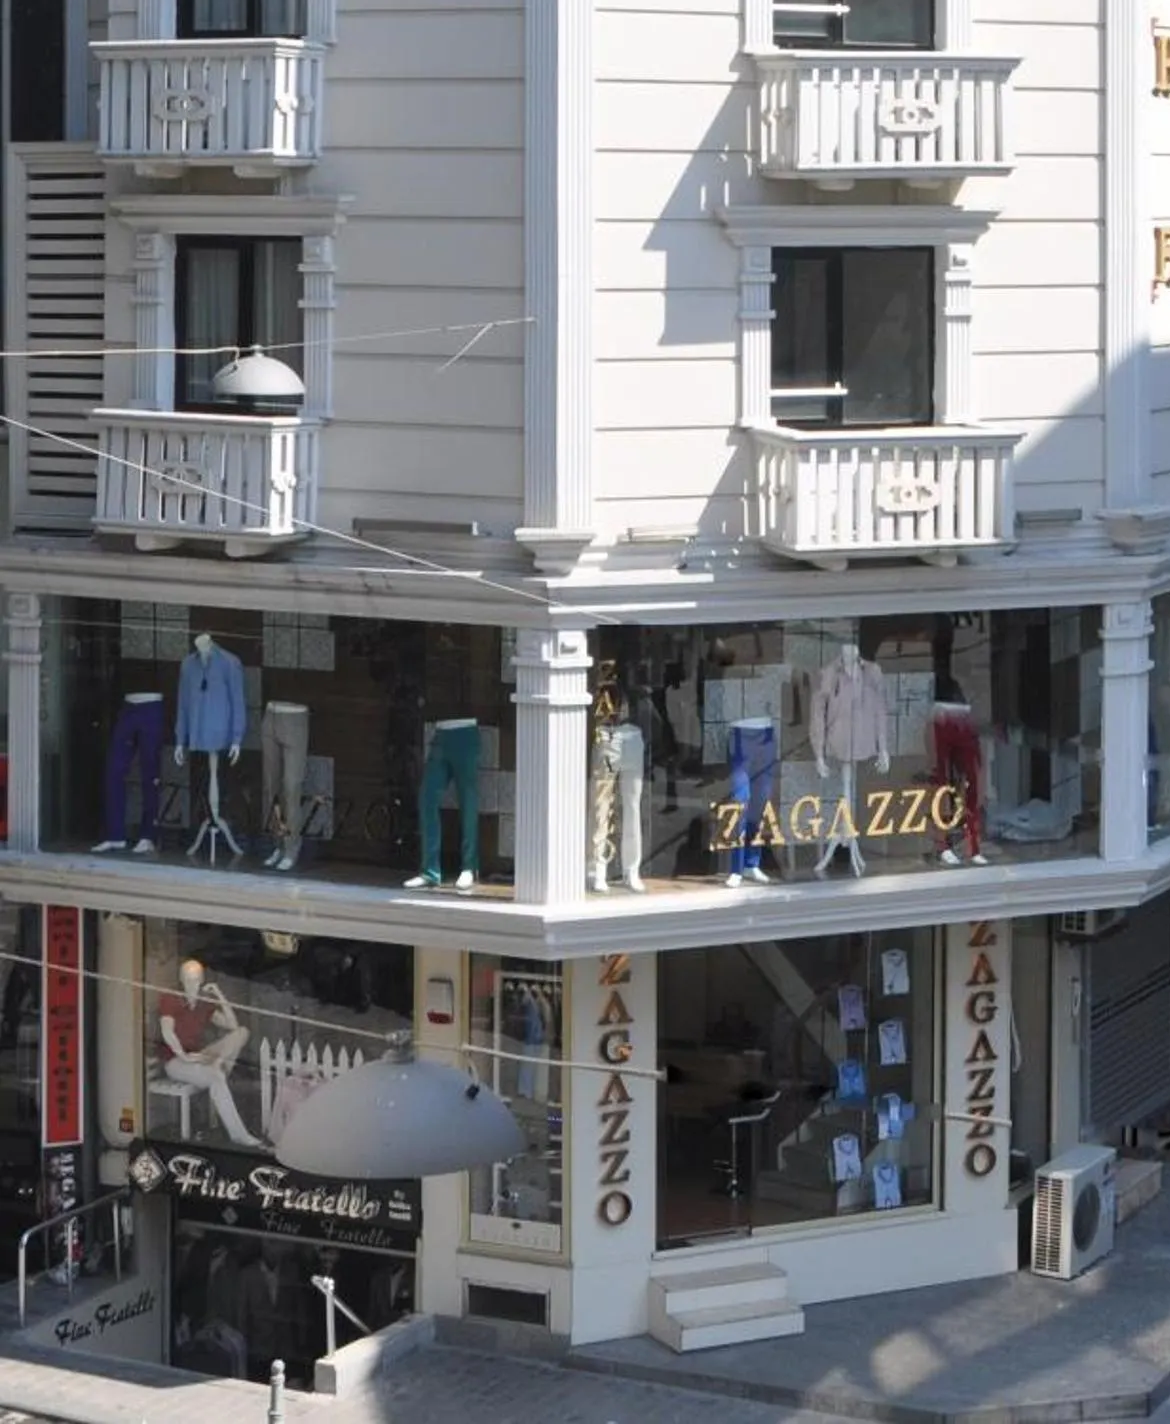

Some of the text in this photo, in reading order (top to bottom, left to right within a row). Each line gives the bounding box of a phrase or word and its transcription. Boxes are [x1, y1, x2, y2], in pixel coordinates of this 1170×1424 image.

[155, 779, 398, 841] ZAAZZO
[709, 784, 965, 853] ZAGAZZO
[965, 920, 999, 1177] ZAGAZZO
[596, 952, 634, 1226] ZAGAZZO
[168, 1154, 244, 1201] Fine
[250, 1165, 381, 1221] Fratello
